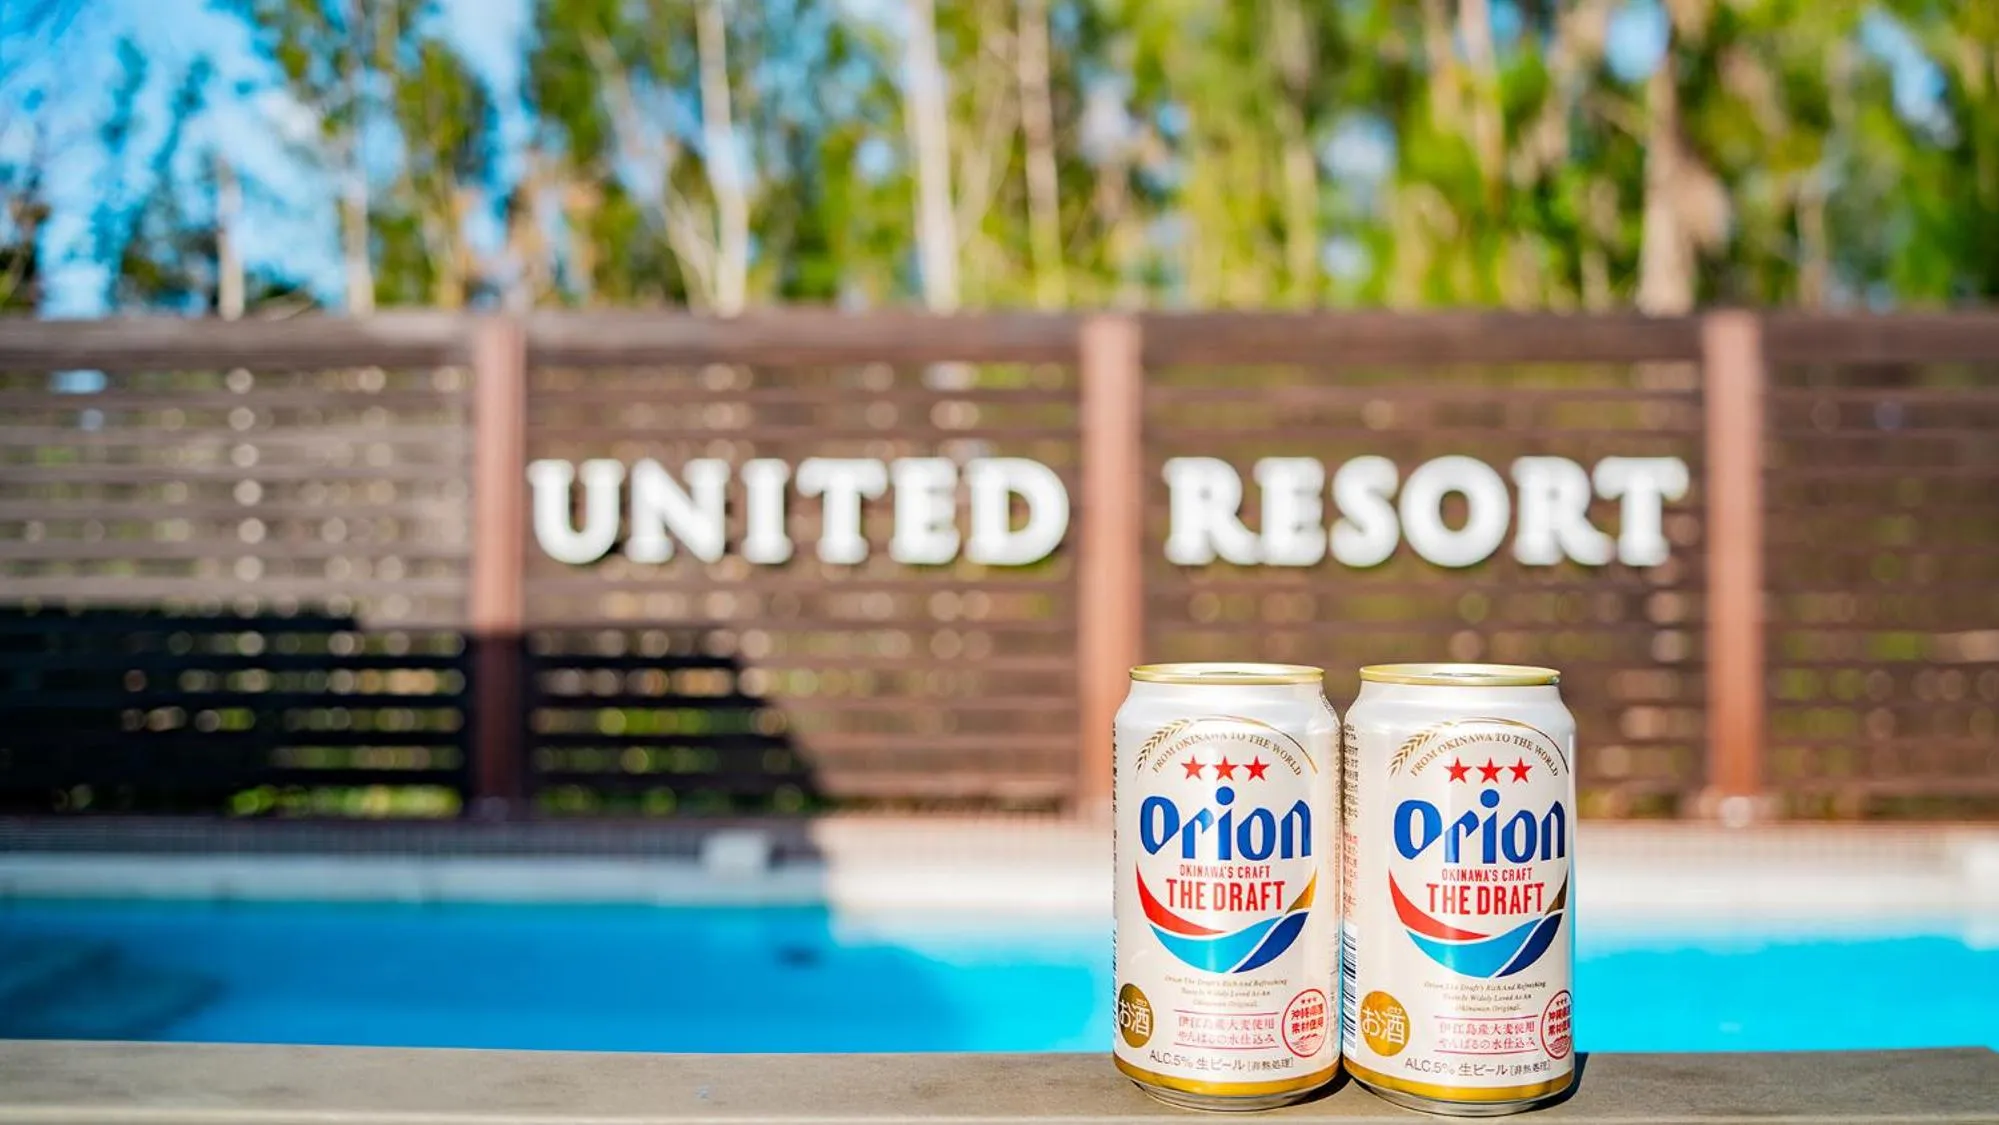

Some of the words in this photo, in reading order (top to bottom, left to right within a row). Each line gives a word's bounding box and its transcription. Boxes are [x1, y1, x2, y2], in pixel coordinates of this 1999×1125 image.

[526, 457, 1070, 565] UNITED
[1161, 455, 1690, 568] RESORT
[1151, 746, 1176, 774] FROM
[1175, 732, 1228, 751] OKINAWA
[1231, 732, 1246, 741] TO
[1249, 734, 1271, 749] THE
[1272, 743, 1302, 777] WORLD
[1410, 749, 1438, 777] FROM
[1437, 733, 1492, 753] OKINAWA
[1495, 733, 1511, 743] TO
[1513, 735, 1533, 751] THE
[1534, 744, 1559, 777] WORLD
[1179, 864, 1234, 879] OKINAWA'S
[1237, 865, 1271, 879] CRAFT
[1442, 868, 1498, 882] OKINAWA'S
[1502, 867, 1533, 881] CRAFT
[1166, 878, 1205, 910] THE
[1213, 880, 1286, 912] DRAFT
[1426, 883, 1471, 915] THE
[1477, 882, 1545, 916] DRAFT
[1118, 998, 1150, 1037] お酒
[1361, 1006, 1406, 1045] お酒
